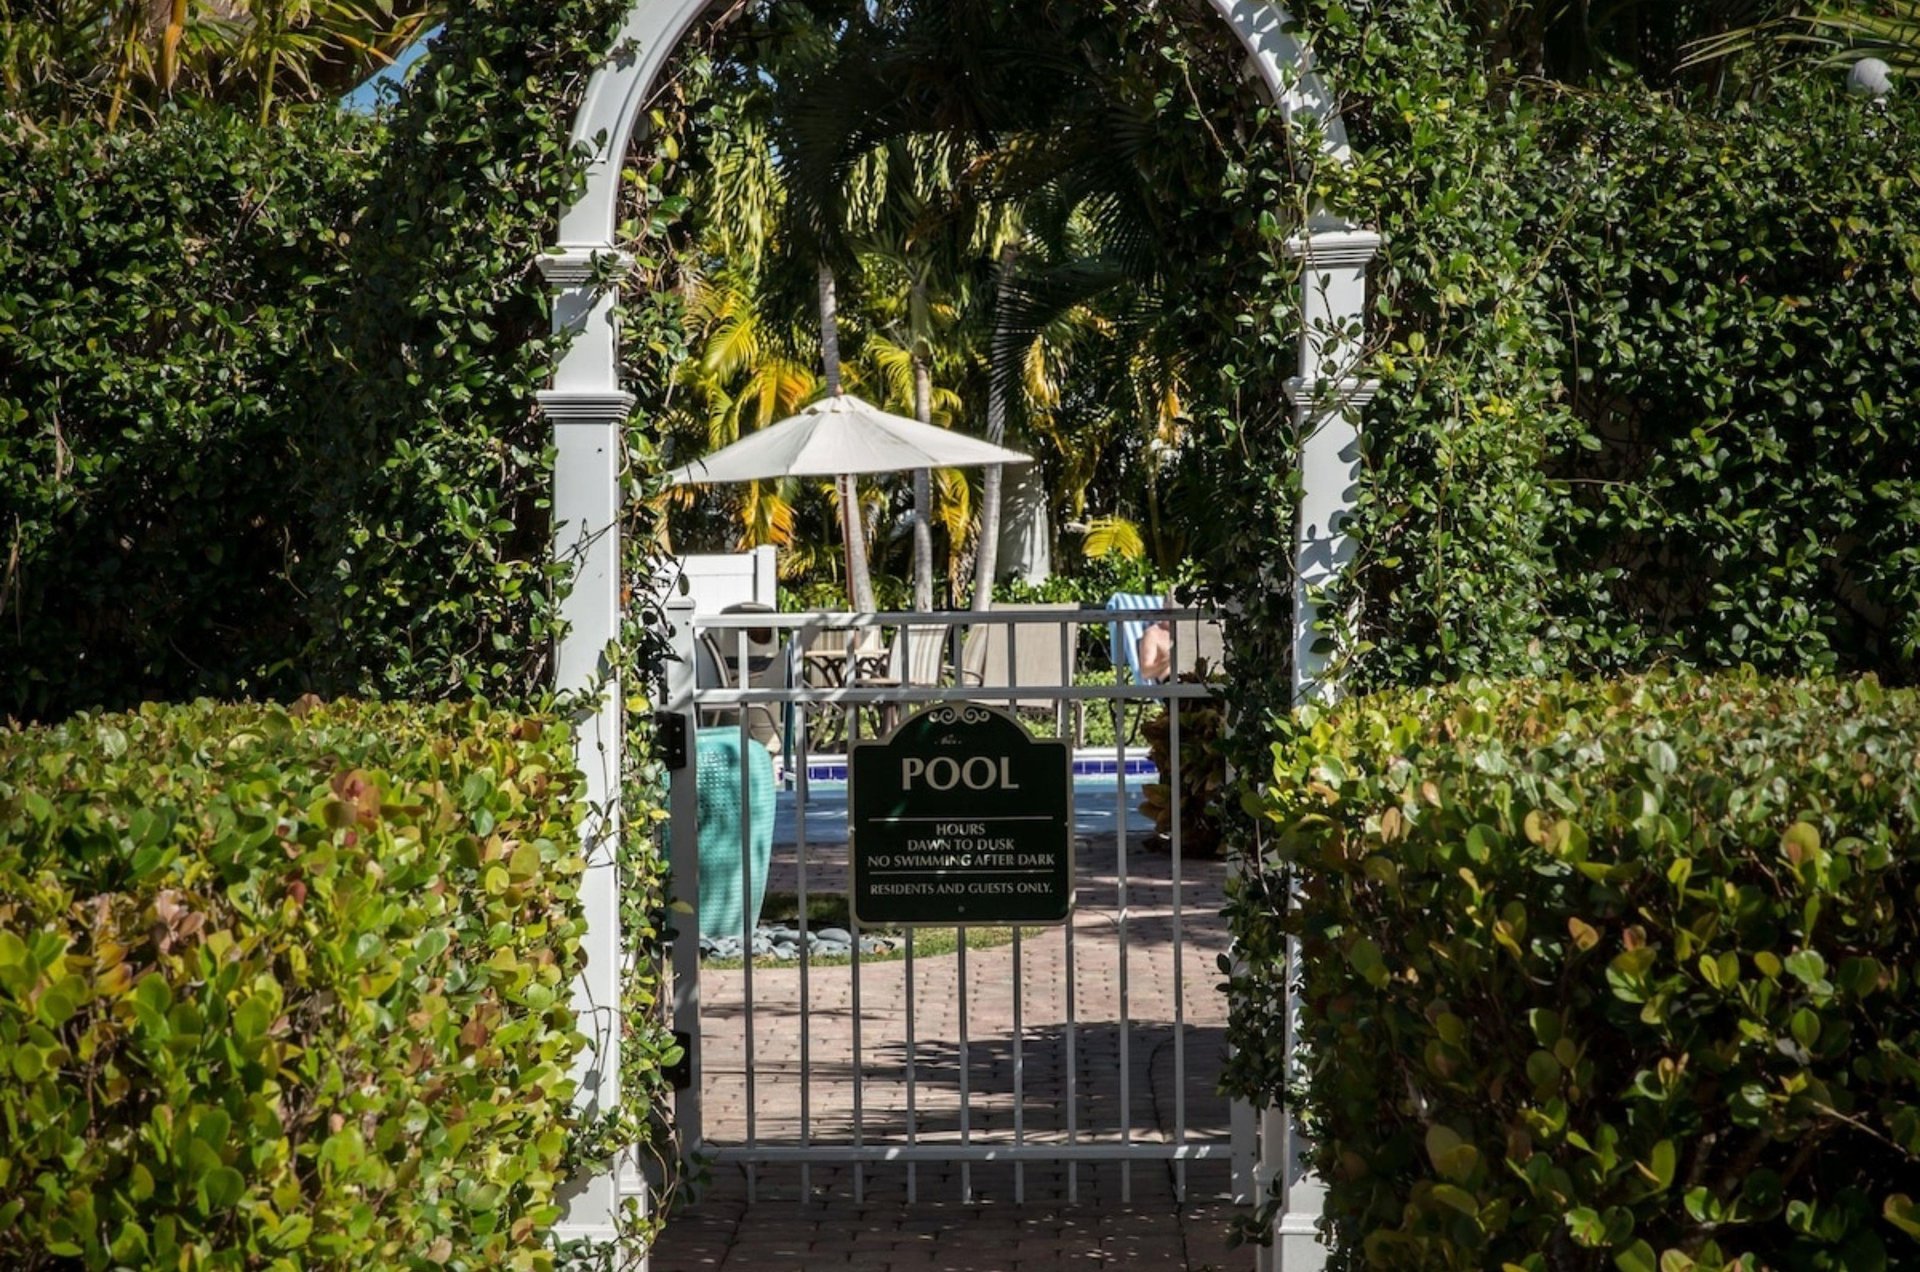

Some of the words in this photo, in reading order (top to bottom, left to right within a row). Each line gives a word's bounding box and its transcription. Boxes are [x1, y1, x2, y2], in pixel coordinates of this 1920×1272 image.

[902, 757, 1019, 790] POOL
[936, 823, 985, 835] HOURS
[908, 838, 951, 851] DAWN
[954, 839, 973, 850] TO
[977, 839, 1014, 851] DUSK
[868, 856, 890, 867] NO
[894, 854, 971, 866] SWIMMING
[974, 854, 1014, 865] AFTER
[1018, 854, 1054, 865] DARK
[871, 884, 934, 894] RESIDENTS
[937, 883, 965, 893] AND
[968, 883, 1013, 893] GUESTS
[1017, 883, 1052, 893] ONLY.
